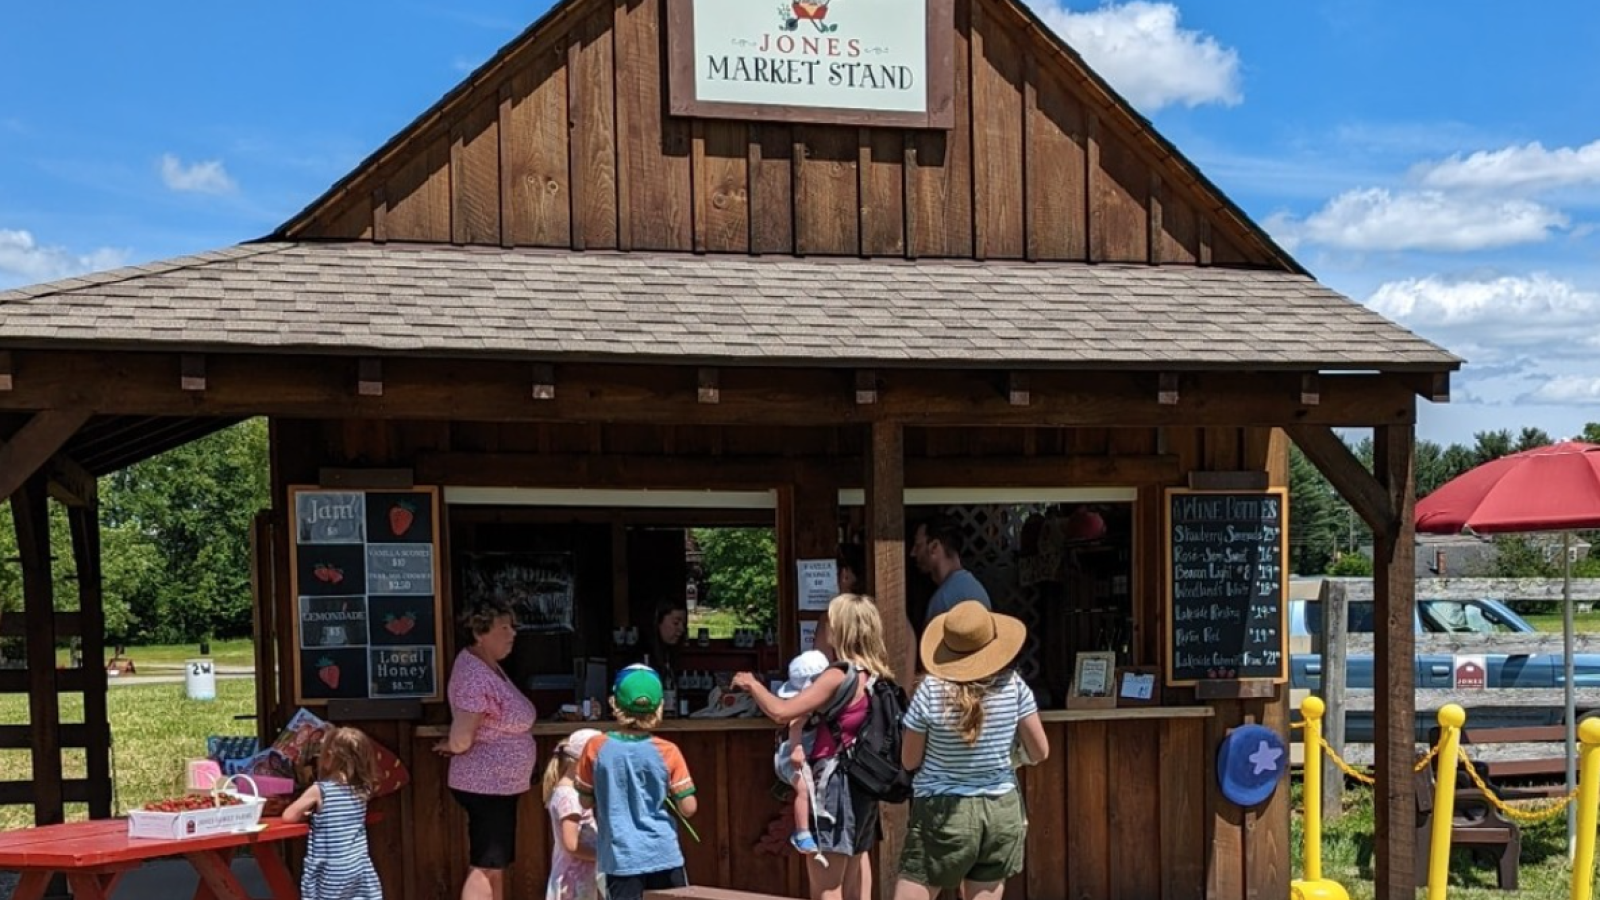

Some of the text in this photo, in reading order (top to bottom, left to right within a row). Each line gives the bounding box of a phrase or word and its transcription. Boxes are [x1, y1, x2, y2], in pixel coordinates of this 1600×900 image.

[760, 34, 861, 58] JONES
[706, 54, 914, 91] MARKET STAND
[307, 499, 355, 523] Jam
[380, 649, 425, 663] Local
[377, 663, 428, 679] Honey
